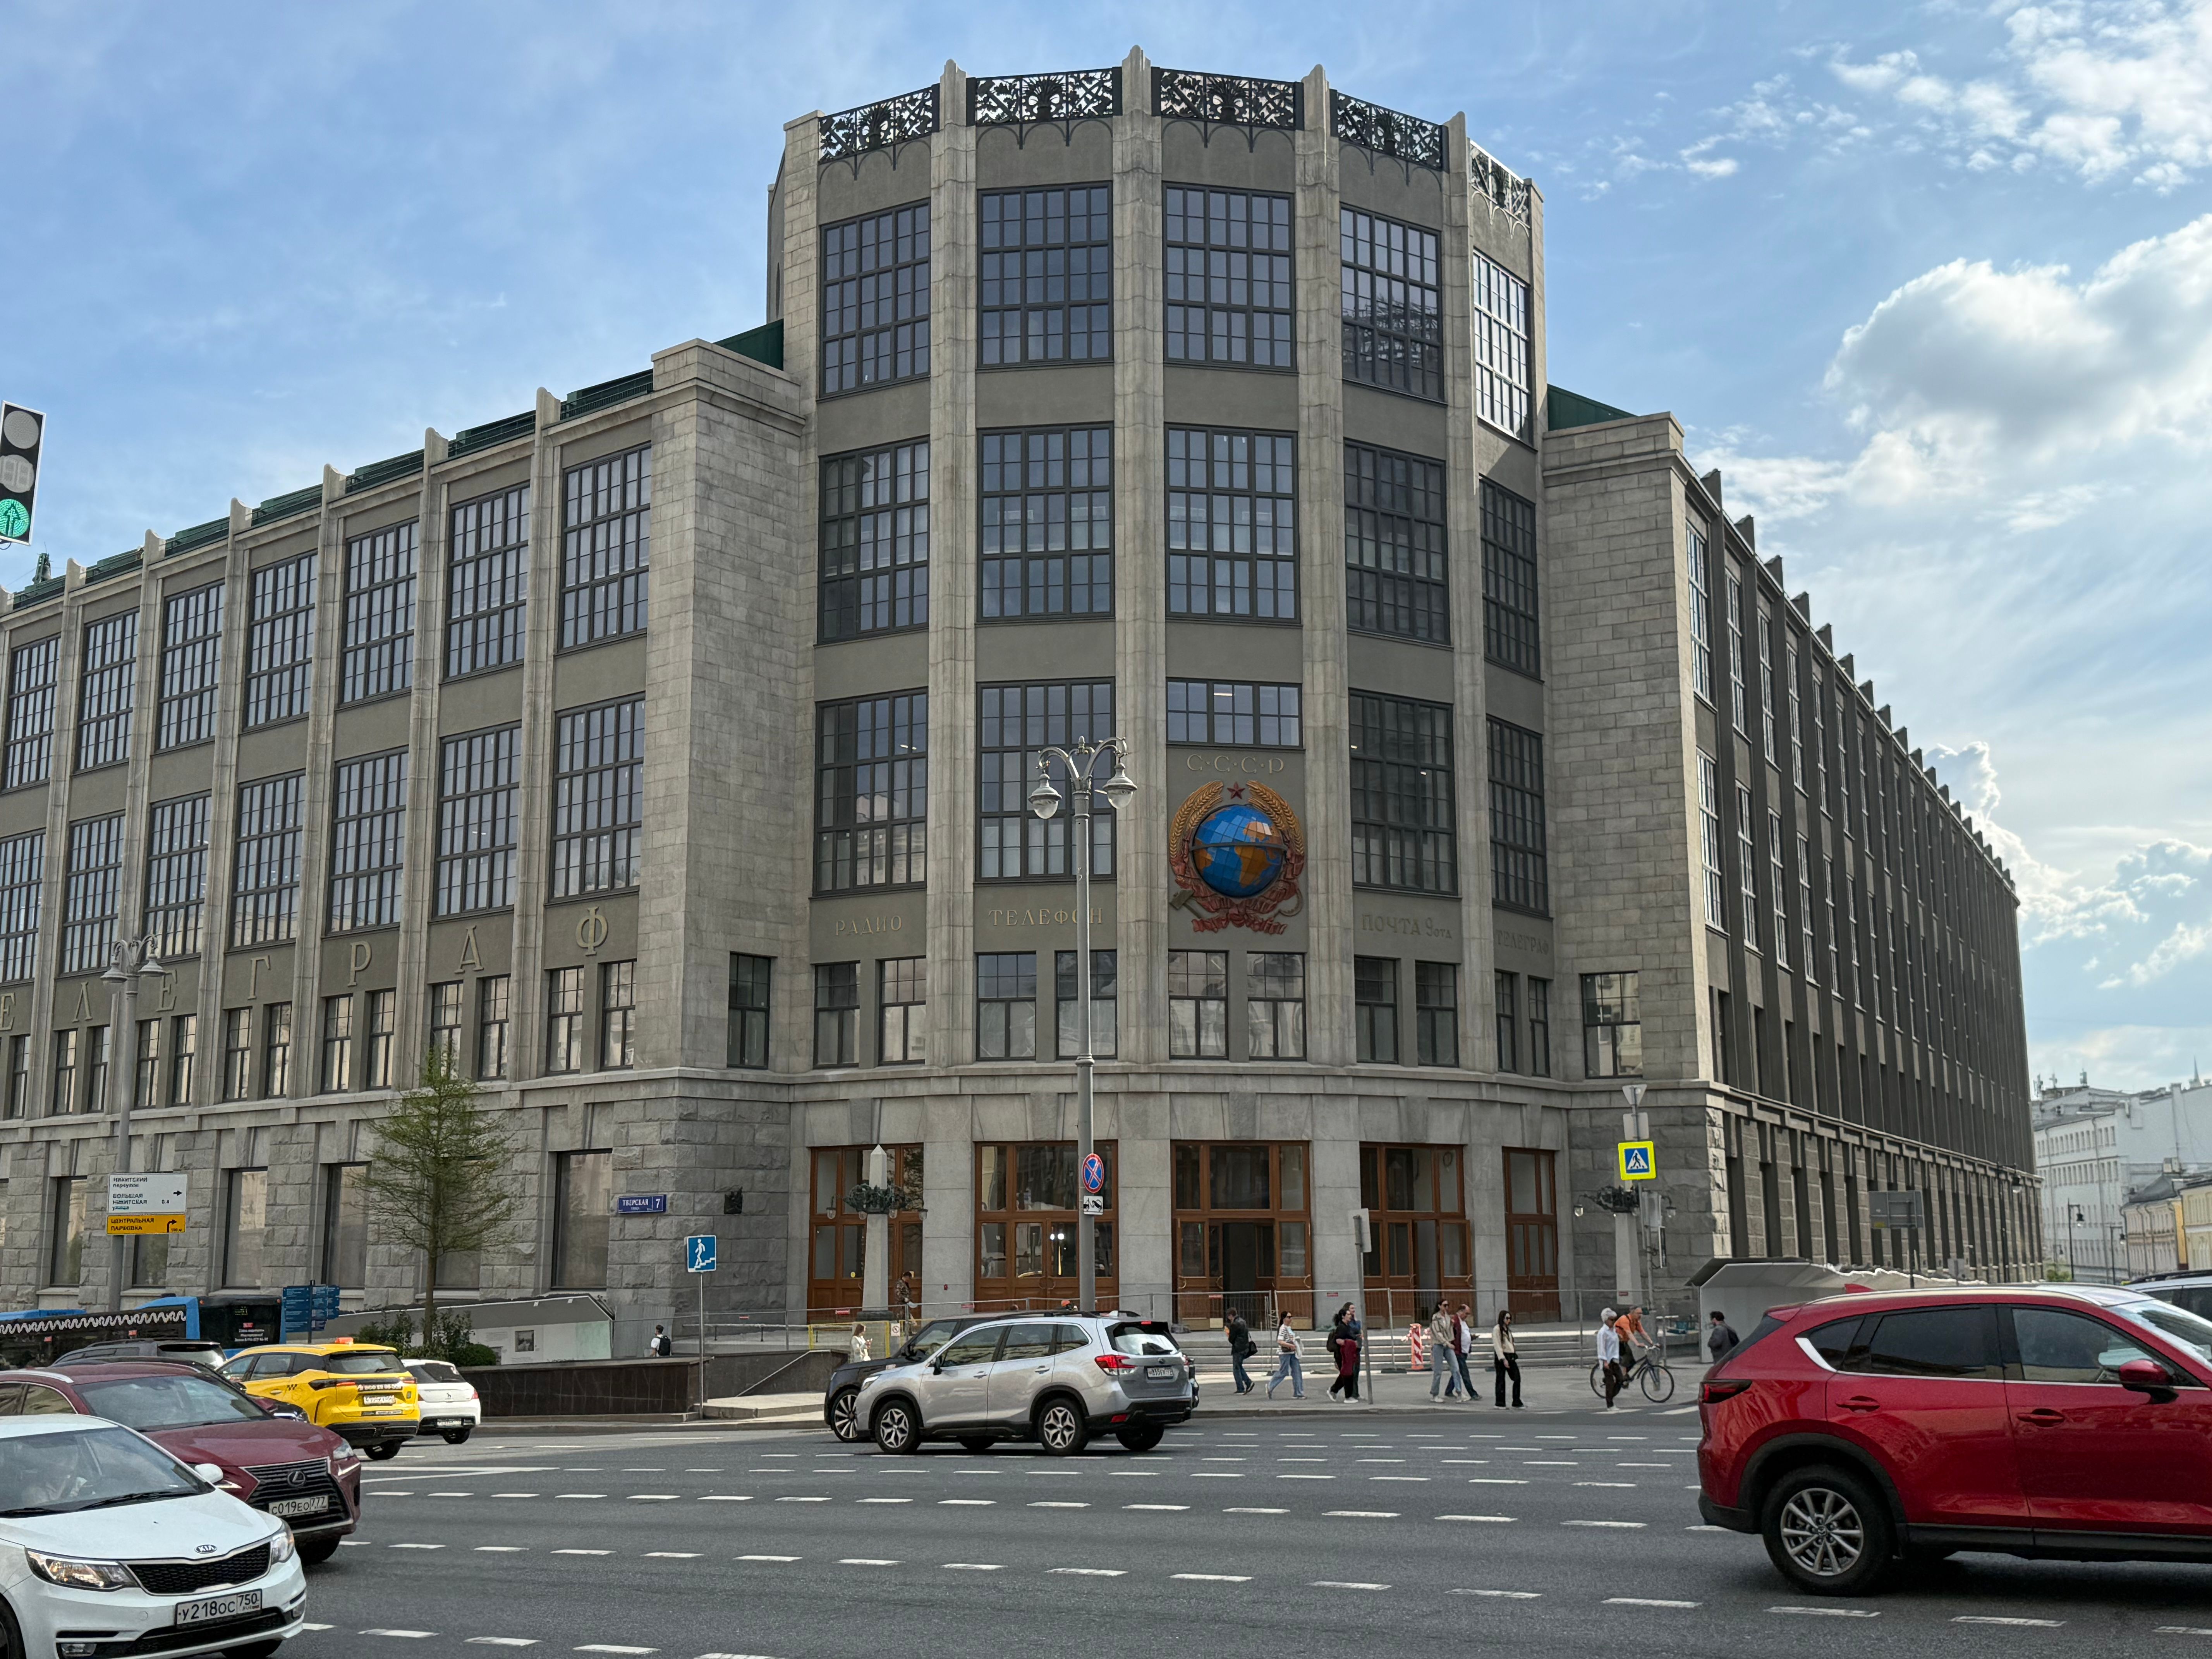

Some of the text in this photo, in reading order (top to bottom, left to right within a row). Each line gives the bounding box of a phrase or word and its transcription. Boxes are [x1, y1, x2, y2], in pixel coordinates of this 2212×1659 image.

[835, 915, 902, 936] РАДИО
[1362, 914, 1421, 935] ПОЧТА
[1496, 929, 1549, 955] ТЕЛЕГРАФ
[656, 1198, 660, 1208] 7
